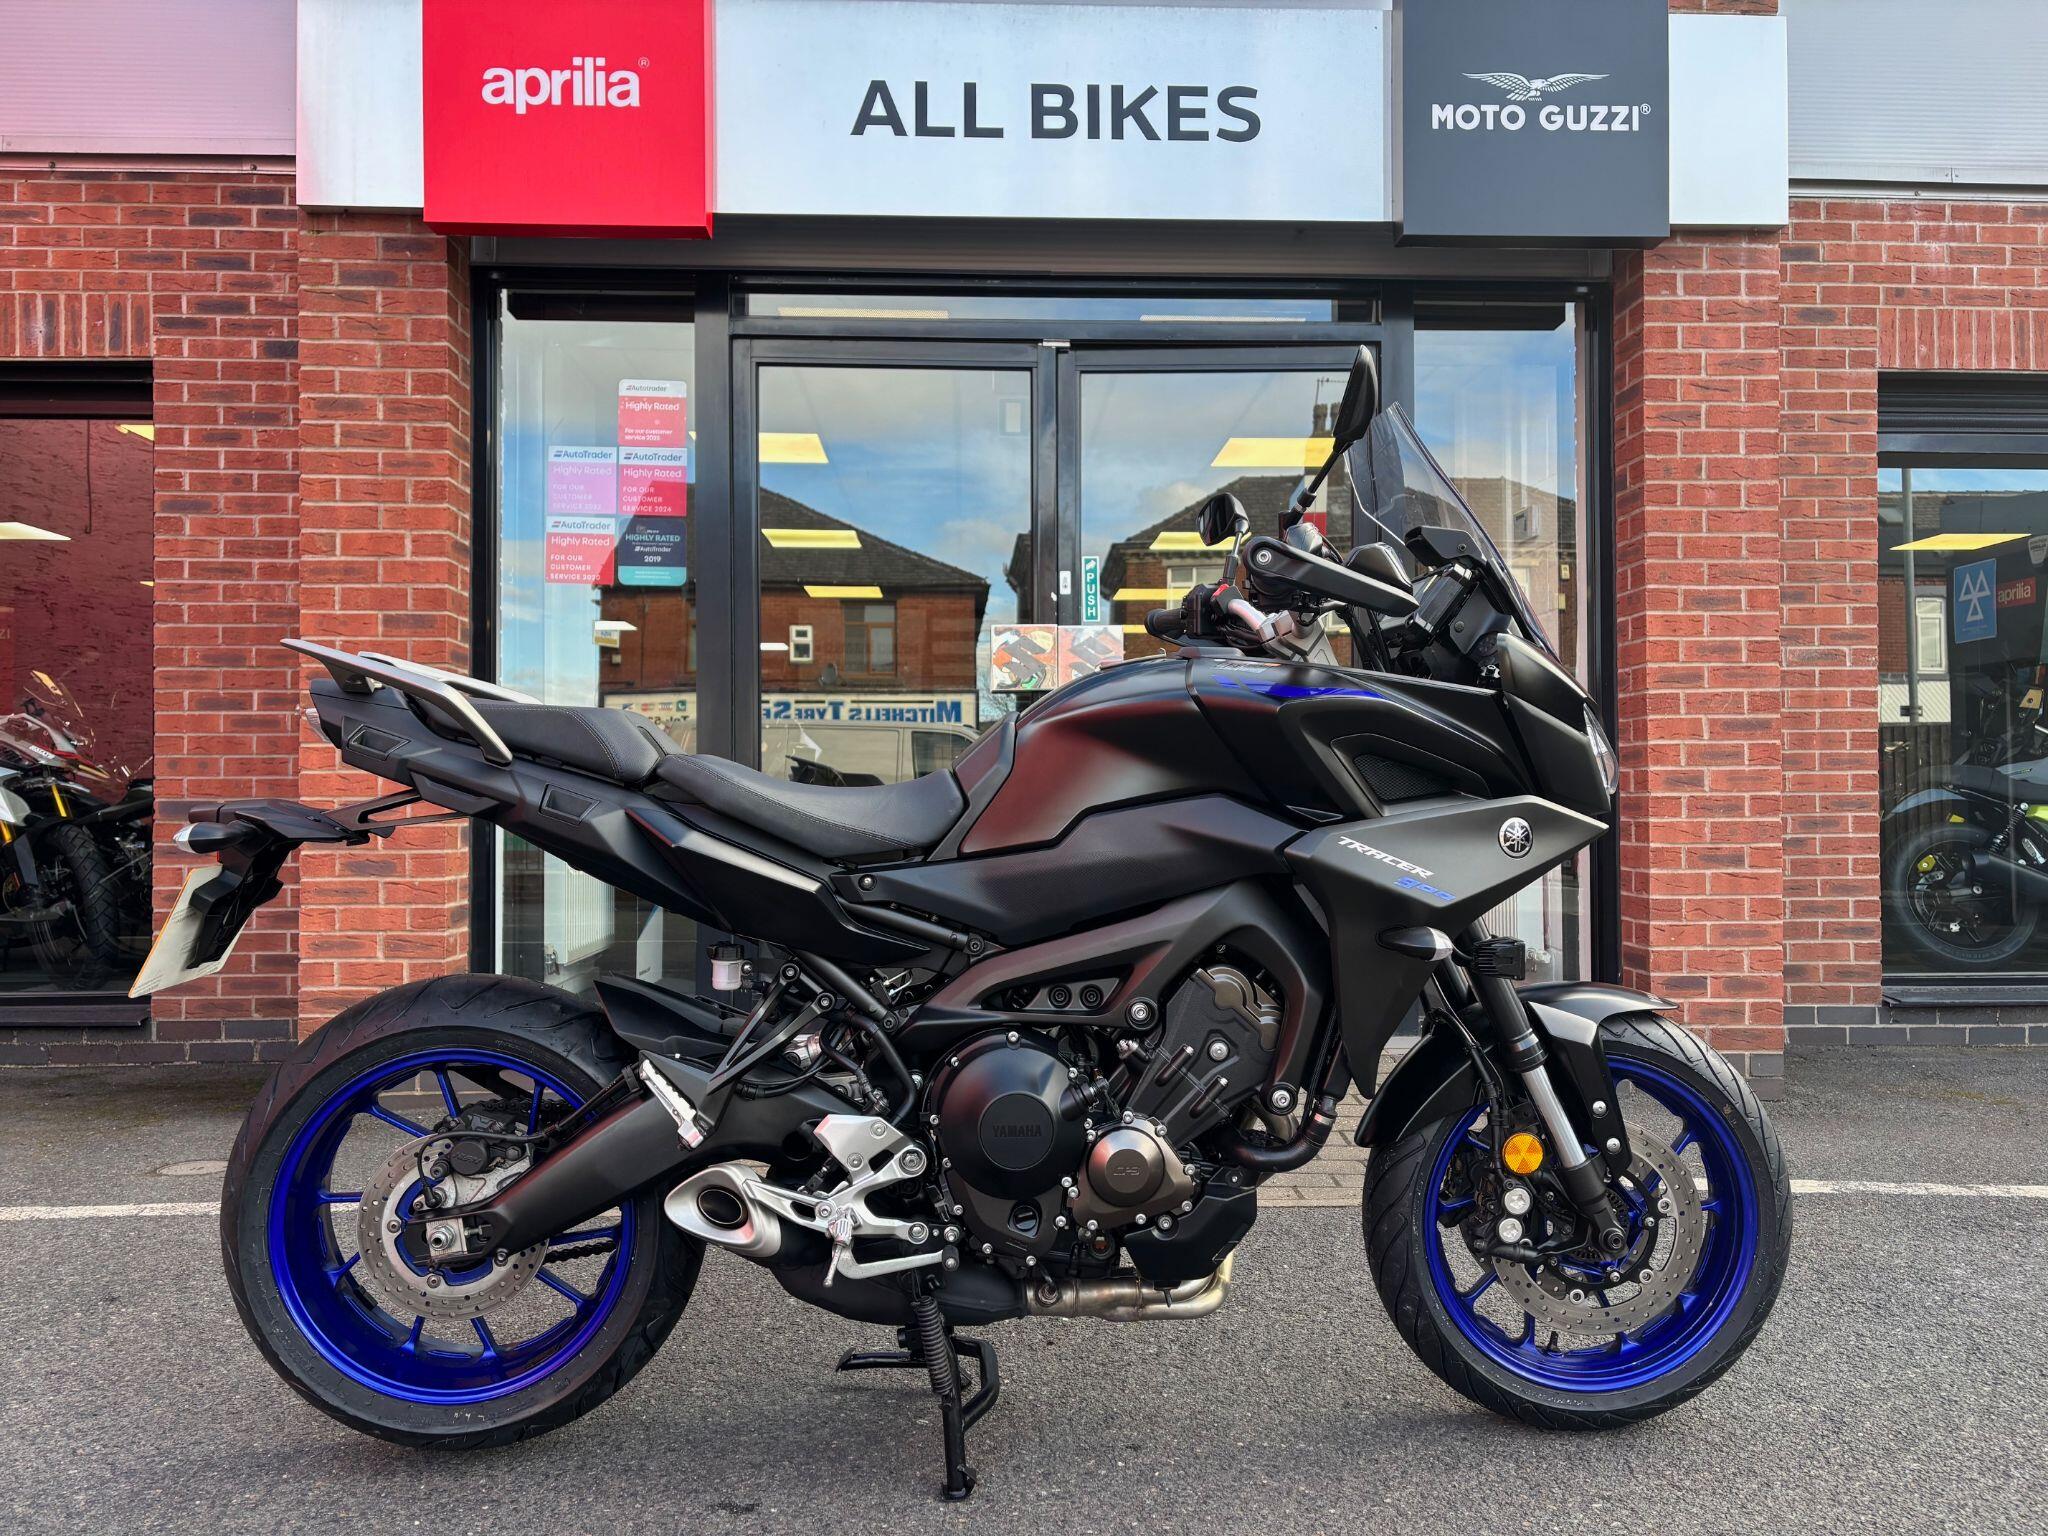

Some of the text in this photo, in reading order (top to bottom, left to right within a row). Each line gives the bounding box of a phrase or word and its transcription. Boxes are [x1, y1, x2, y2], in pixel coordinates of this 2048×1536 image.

[850, 79, 1261, 142] ALL BIKES
[1432, 103, 1526, 131] MOTO
[625, 401, 681, 412] Highly Rated
[562, 450, 613, 460] AutoTrader
[632, 453, 683, 462] AutoTrader
[623, 468, 682, 479] Highly Rated
[639, 486, 656, 494] OUR
[622, 495, 663, 504] CUSTOMER
[622, 505, 653, 513] SERVICE
[560, 520, 612, 530] AutoTrader
[551, 536, 610, 547] Highly Rated
[625, 533, 681, 542] HIGHLY RATED
[644, 555, 662, 563] 2019
[550, 563, 592, 571] CUSTOMER
[550, 573, 580, 581] SERVICE
[1086, 572, 1096, 617] PUSH
[1998, 582, 2032, 605] aprilia
[1338, 836, 1434, 879] TRACER
[1394, 876, 1456, 901] 900
[992, 1124, 1042, 1138] YAMAHA
